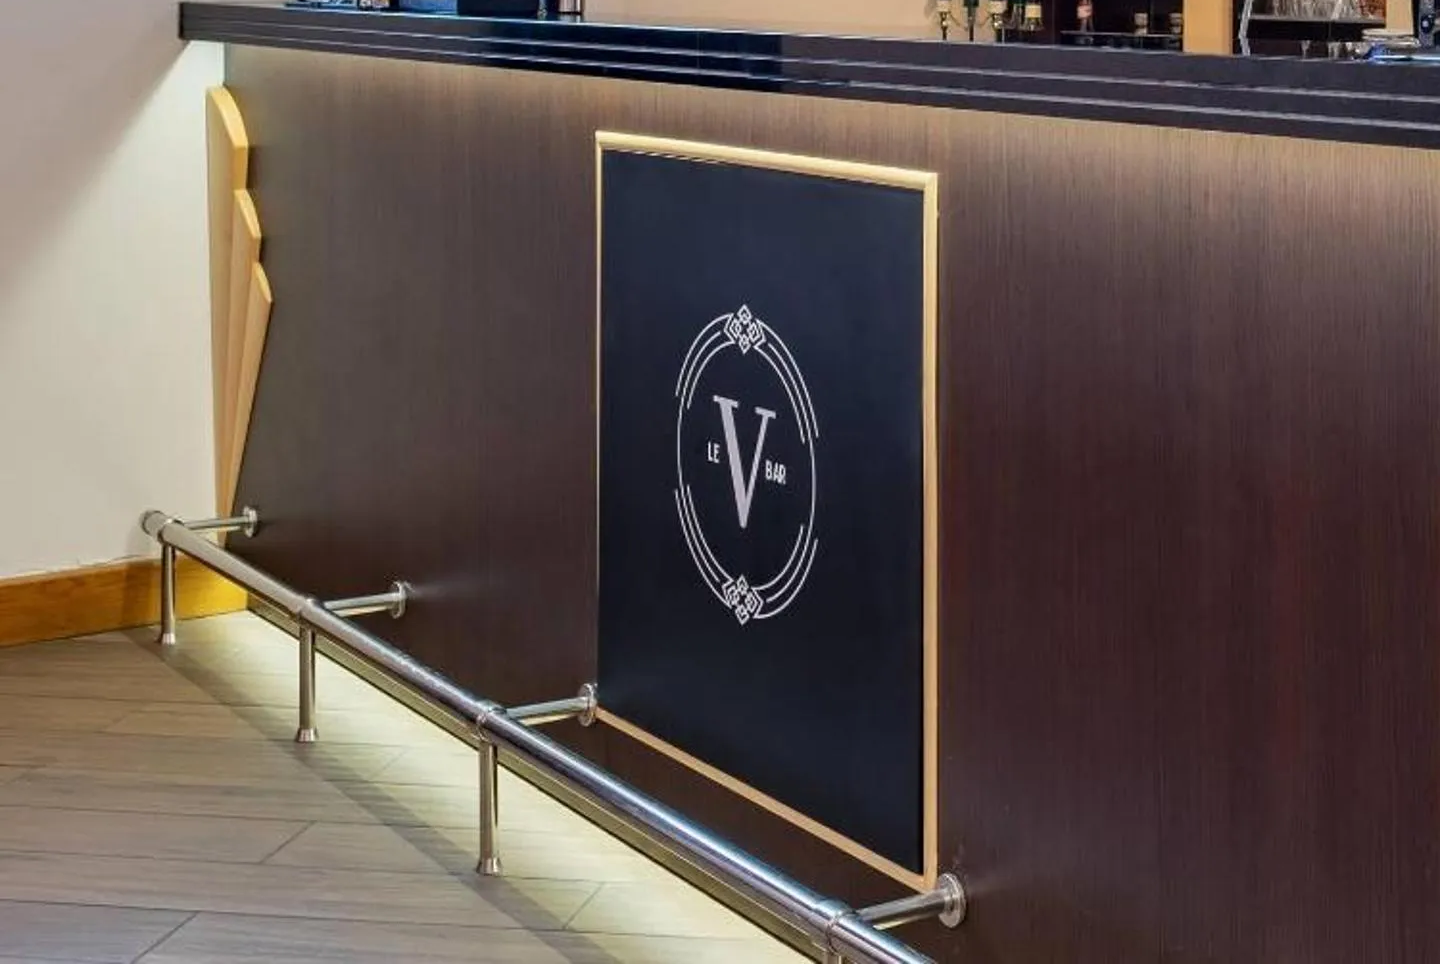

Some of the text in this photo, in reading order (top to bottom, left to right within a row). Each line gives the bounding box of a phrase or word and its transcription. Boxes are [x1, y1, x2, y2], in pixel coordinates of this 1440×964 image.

[707, 395, 787, 529] LE V BAR
